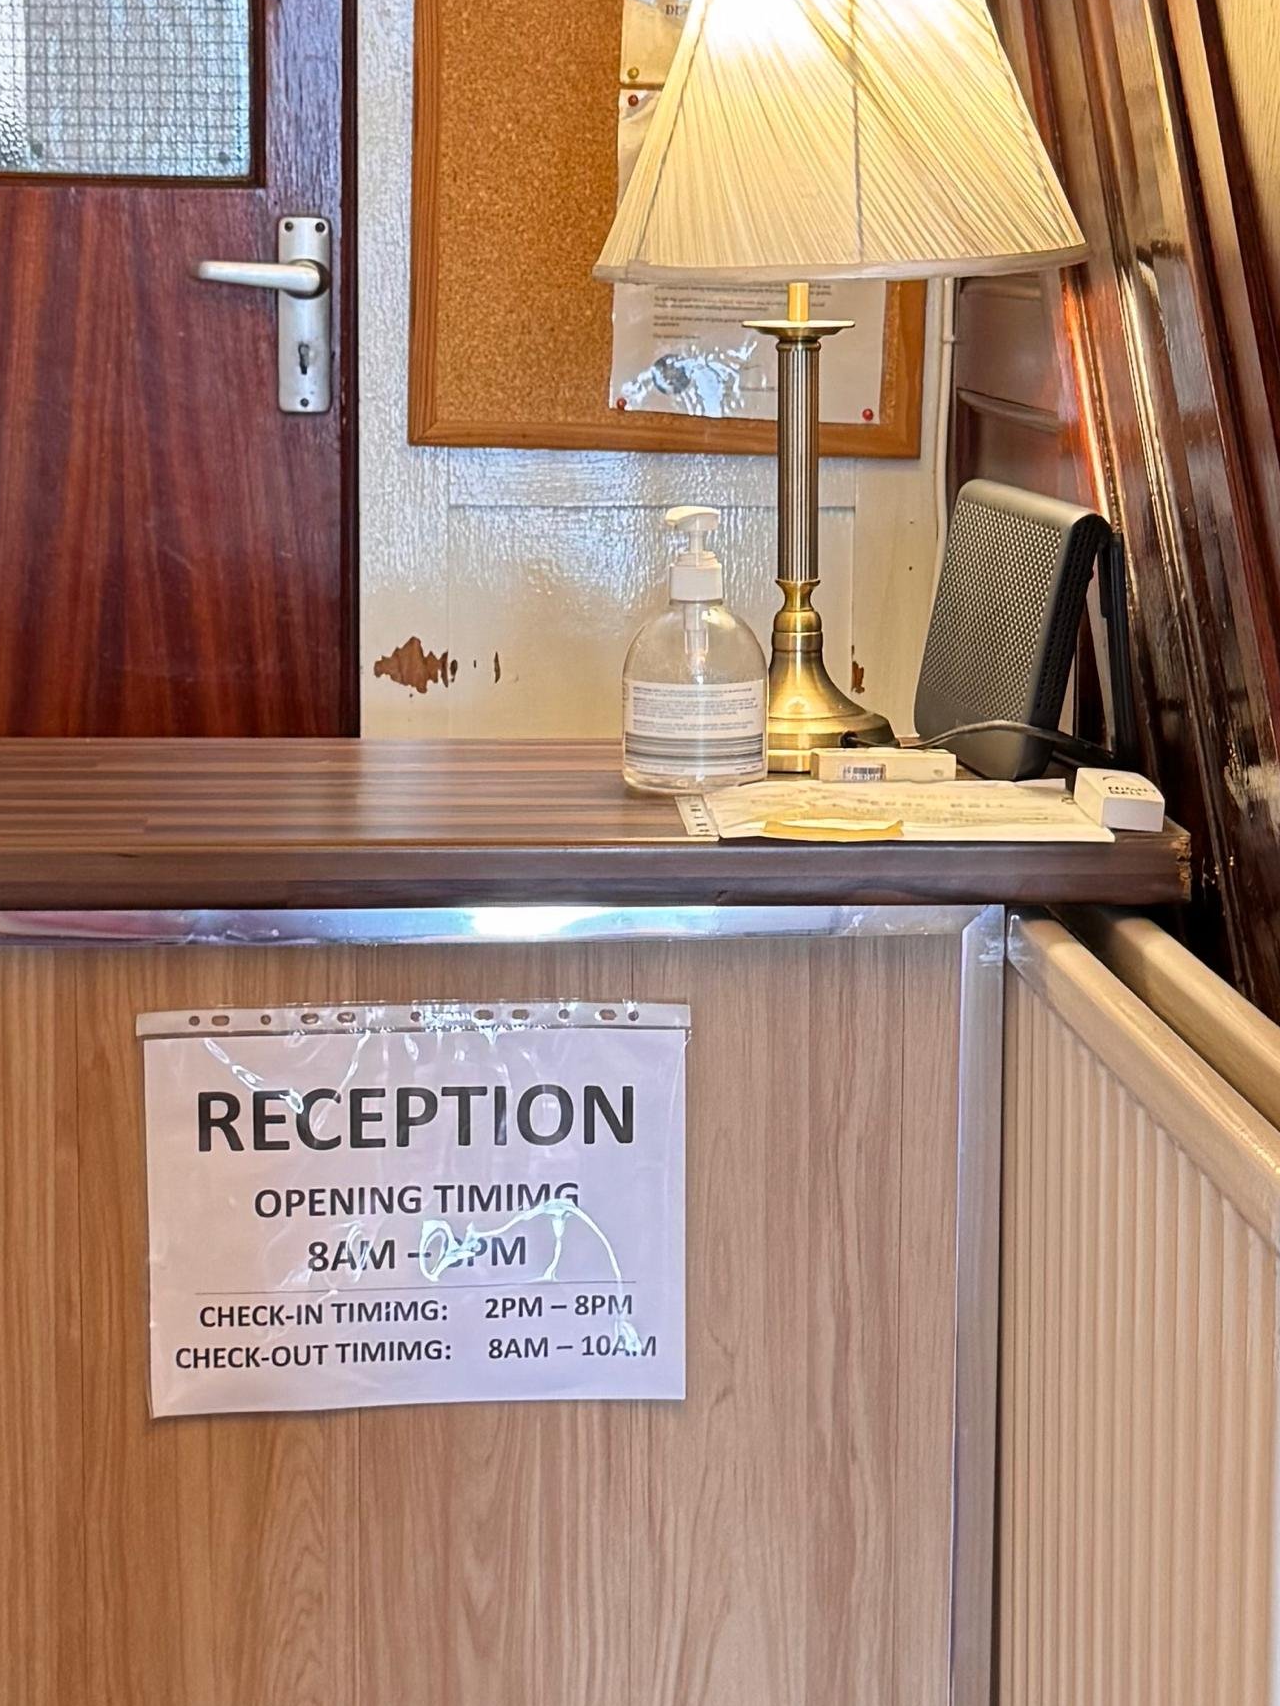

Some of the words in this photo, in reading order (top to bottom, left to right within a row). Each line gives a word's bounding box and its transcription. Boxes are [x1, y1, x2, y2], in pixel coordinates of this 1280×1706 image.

[197, 1084, 635, 1153] RECEPTION
[254, 1184, 421, 1218] OPENING
[433, 1182, 579, 1213] TIMIMG
[307, 1238, 396, 1272] 8AM
[199, 1303, 323, 1327] CHECK-IN
[331, 1300, 448, 1323] TIMIMG:
[485, 1296, 543, 1319] 2PM
[574, 1294, 633, 1316] 8PM
[175, 1343, 329, 1369] CHECK-OUT
[336, 1340, 452, 1363] TIMIMG:
[488, 1337, 549, 1359] 8AM
